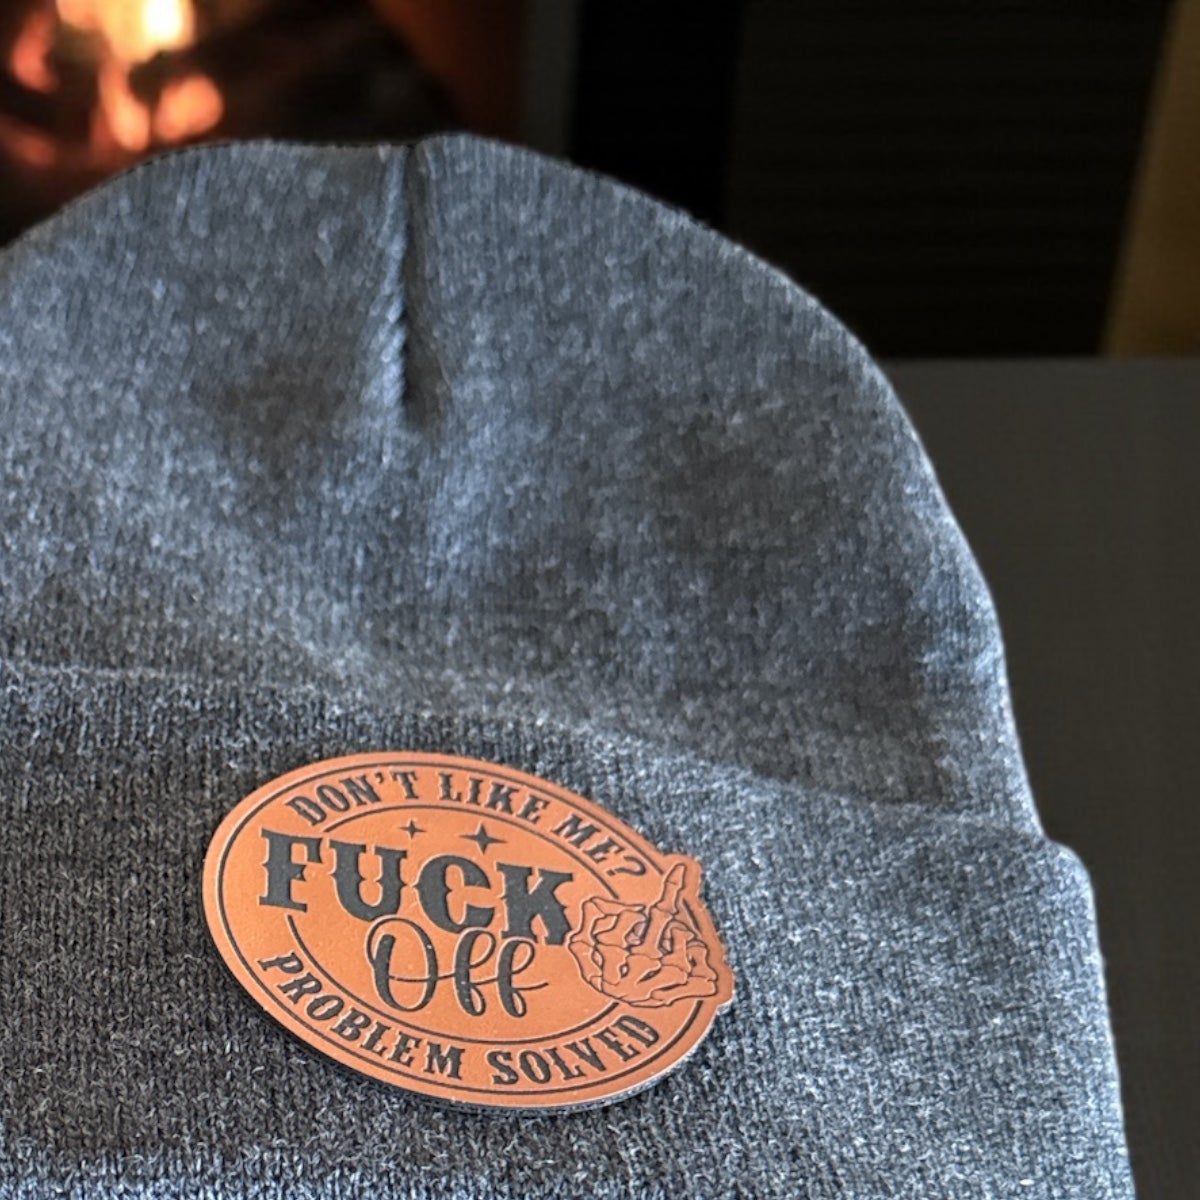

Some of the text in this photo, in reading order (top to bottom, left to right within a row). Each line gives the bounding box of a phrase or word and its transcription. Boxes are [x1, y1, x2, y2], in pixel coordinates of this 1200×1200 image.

[284, 770, 647, 881] DON'T LIKE ME?
[259, 828, 575, 946] FUCK
[257, 951, 660, 1086] PROBLEM SOLVED
[367, 917, 548, 1019] Off
